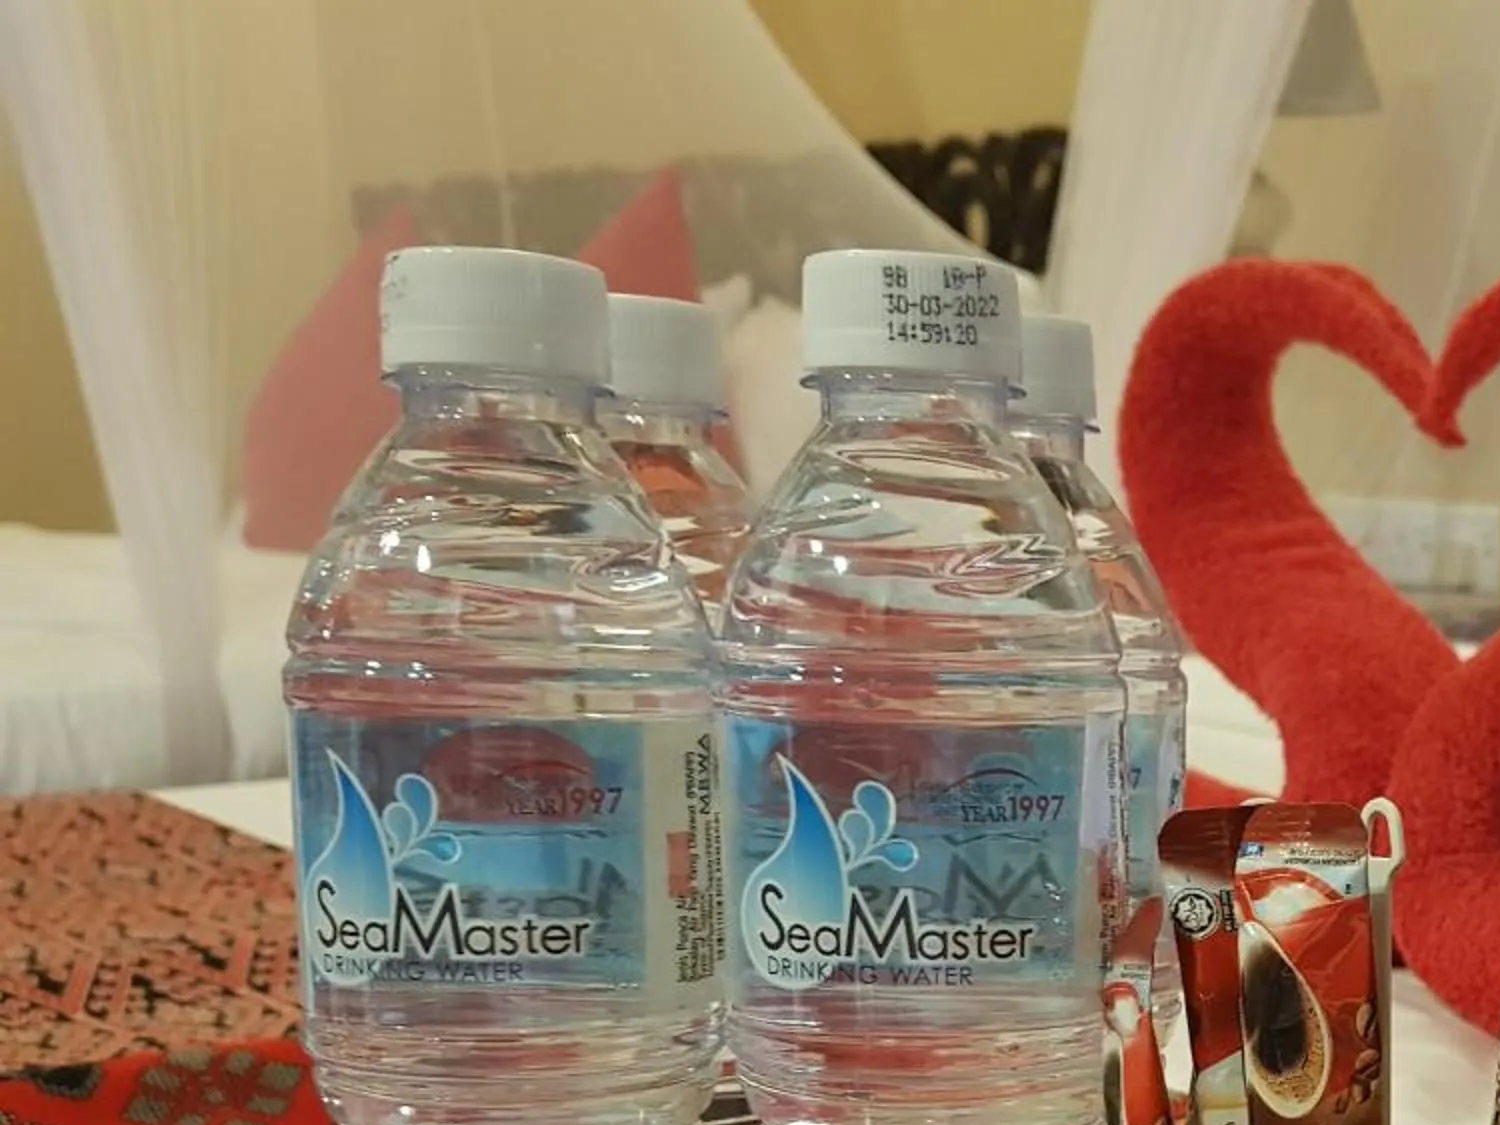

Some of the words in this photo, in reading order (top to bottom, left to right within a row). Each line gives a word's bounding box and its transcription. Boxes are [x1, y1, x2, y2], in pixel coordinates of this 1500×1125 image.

[882, 294, 1000, 318] 30-03-2022
[887, 321, 978, 345] 14:59:20
[558, 787, 624, 816] 1997
[961, 802, 1006, 823] YEAR
[1007, 794, 1065, 822] 1997
[316, 879, 590, 956] SeaMaster
[759, 884, 1034, 961] SeaMaster
[323, 954, 425, 982] DRINKING
[435, 961, 524, 983] WATER
[767, 956, 878, 986] DRINKING
[888, 966, 974, 987] WATER
